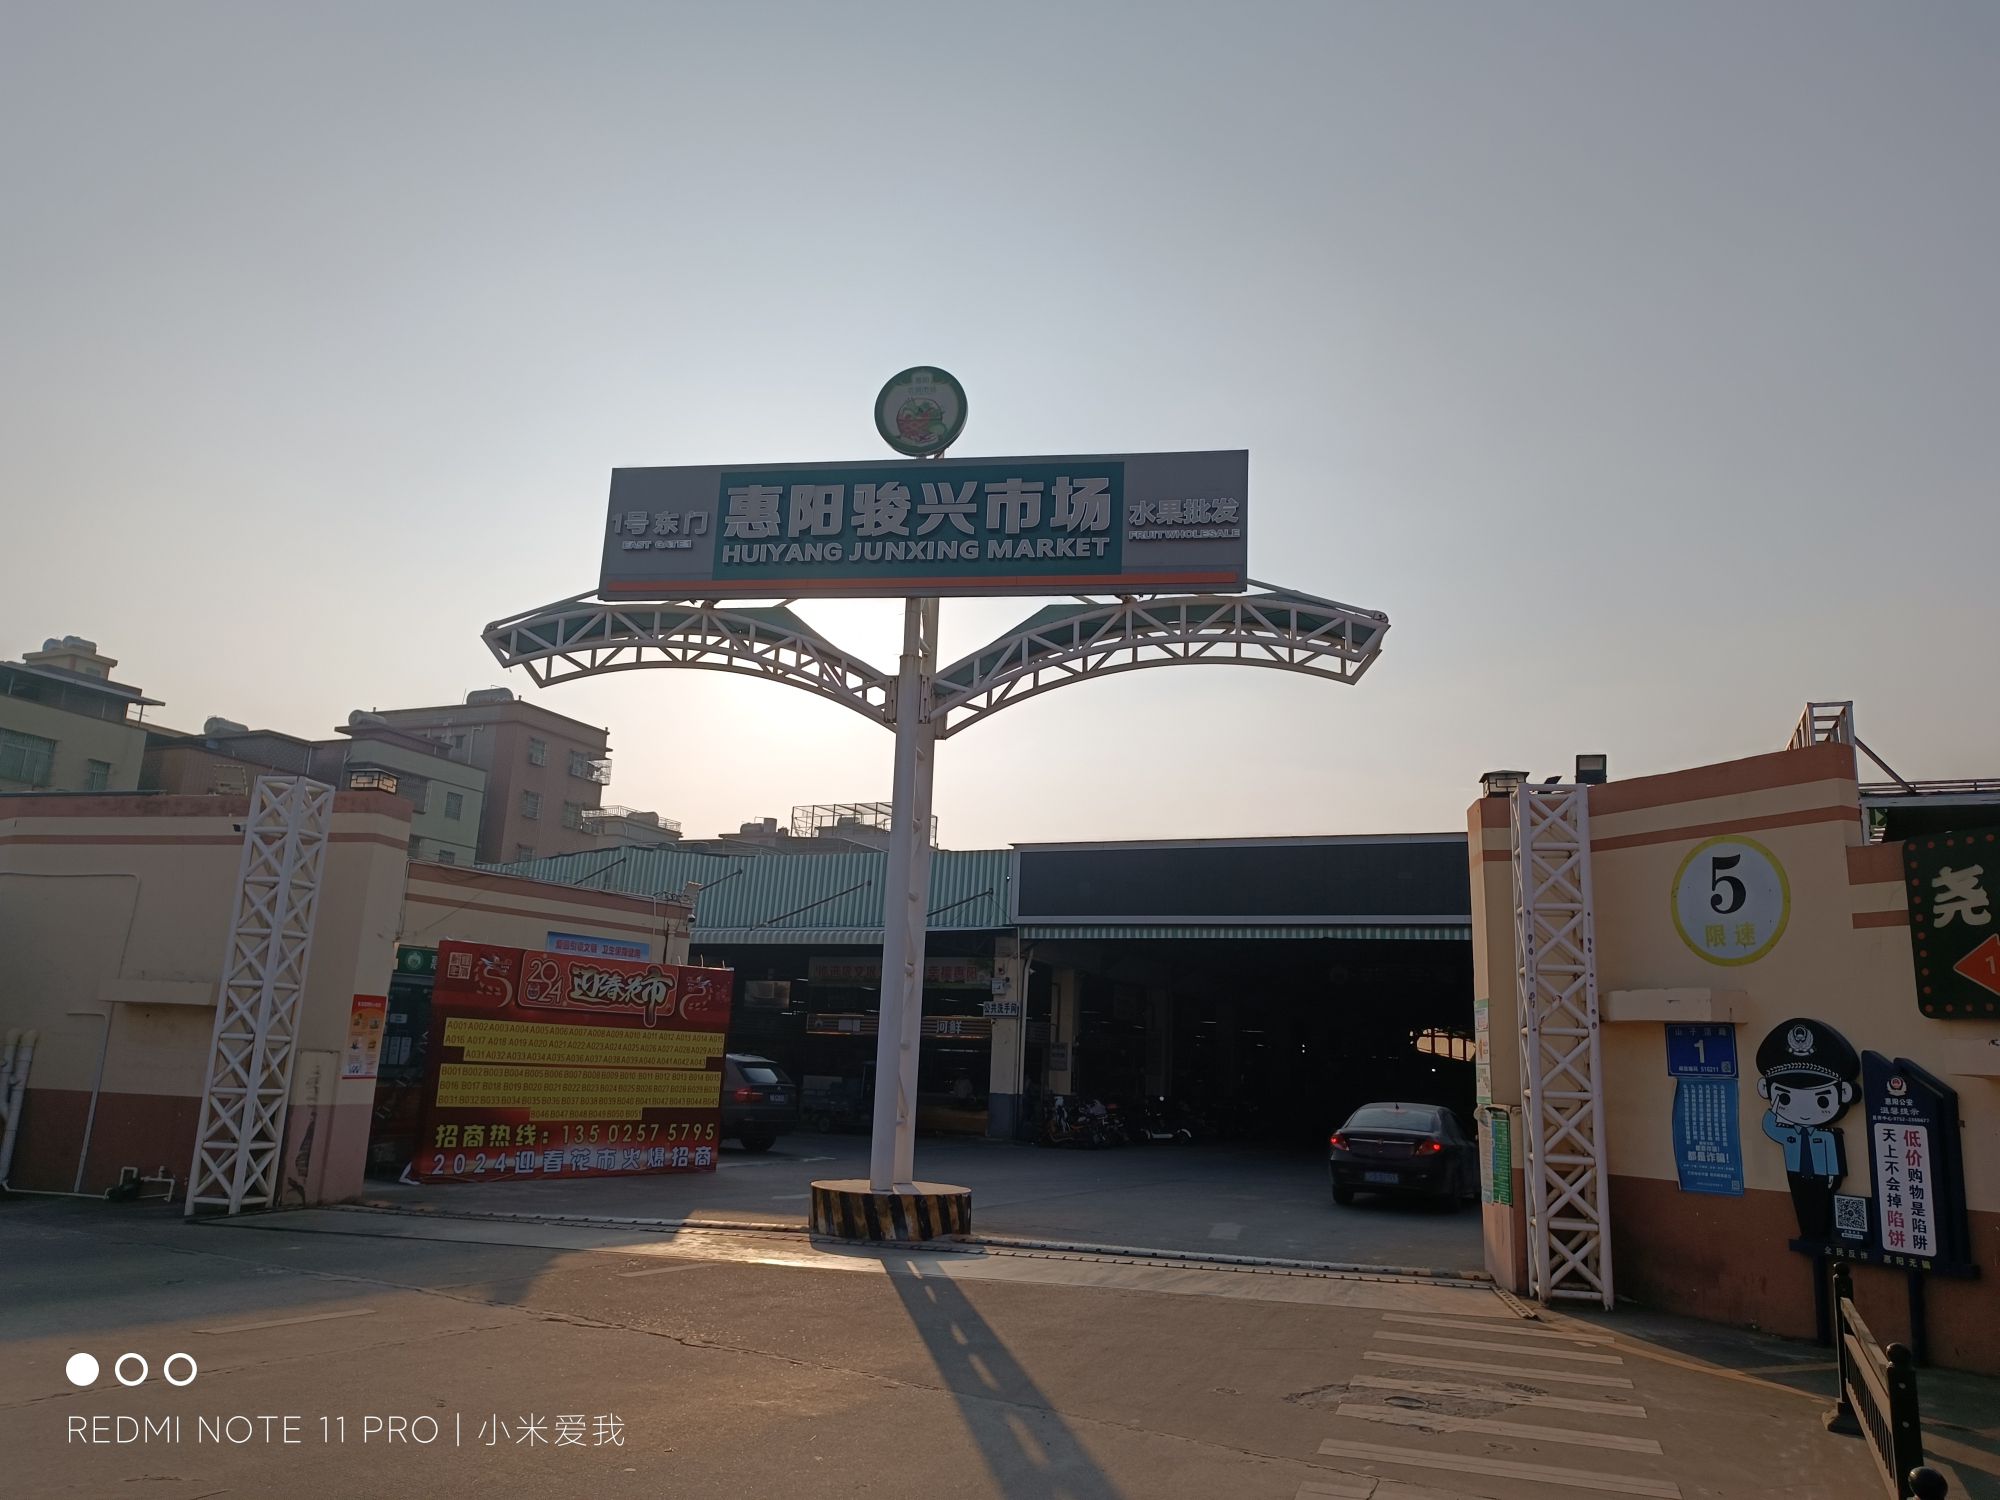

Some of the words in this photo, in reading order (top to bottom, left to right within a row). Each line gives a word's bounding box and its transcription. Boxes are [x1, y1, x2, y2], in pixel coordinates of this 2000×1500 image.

[722, 476, 1111, 539] 惠阳骏兴市场
[1128, 498, 1240, 525] 水果批发
[612, 510, 709, 535] 1号东门
[623, 540, 652, 550] EAST
[722, 542, 843, 563] HUIYANG
[848, 540, 979, 562] JUNXING
[987, 537, 1111, 560] MARKET
[1710, 854, 1747, 914] 5
[1931, 863, 1992, 929] 尧
[1704, 923, 1756, 948] 限速
[1985, 955, 1997, 975] 1
[447, 1021, 466, 1031] A001
[467, 1022, 488, 1033] A002
[489, 1023, 508, 1033] A003
[509, 1024, 528, 1034] A004
[529, 1025, 548, 1035] A005
[550, 1026, 568, 1036] A006
[570, 1028, 586, 1037] A007
[588, 1029, 606, 1038] A008
[606, 1030, 624, 1039] A009
[624, 1031, 641, 1040] A010
[642, 1032, 658, 1041] A011
[659, 1033, 674, 1042] A012
[676, 1034, 690, 1042] A013
[692, 1035, 707, 1043] A014
[446, 1035, 464, 1045] A016
[468, 1036, 486, 1045] A017
[488, 1037, 506, 1046] A018
[510, 1038, 528, 1047] A019
[530, 1039, 547, 1048] A020
[548, 1040, 566, 1049] A021
[567, 1041, 586, 1049] A022
[587, 1042, 605, 1050] A023
[606, 1043, 622, 1051] A024
[622, 1044, 640, 1052] A025
[640, 1044, 657, 1052] A026
[658, 1045, 674, 1053] A027
[674, 1046, 690, 1054] A028
[1694, 1039, 1705, 1064] 1
[466, 1050, 484, 1059] A031
[486, 1051, 506, 1060] A032
[507, 1051, 526, 1061] A033
[527, 1052, 546, 1061] A034
[546, 1053, 565, 1062] A035
[566, 1054, 584, 1063] A036
[585, 1055, 602, 1063] A037
[604, 1056, 621, 1064] A038
[622, 1056, 639, 1064] A039
[639, 1057, 656, 1065] A040
[656, 1058, 673, 1066] A041
[442, 1066, 461, 1076] B001
[462, 1067, 484, 1077] B002
[484, 1068, 504, 1077] B003
[504, 1068, 524, 1078] B004
[524, 1069, 544, 1078] B005
[544, 1070, 563, 1079] B006
[564, 1070, 582, 1079] B007
[583, 1071, 601, 1080] B008
[602, 1071, 619, 1080] B009
[620, 1072, 636, 1080] B010
[638, 1072, 654, 1081] B011
[655, 1073, 670, 1081] B012
[672, 1073, 687, 1082] B013
[688, 1074, 704, 1082] B014
[440, 1081, 459, 1090] B016
[462, 1081, 481, 1091] B017
[483, 1082, 502, 1091] B018
[504, 1082, 522, 1091] B019
[523, 1083, 542, 1092] B020
[544, 1083, 561, 1092] B021
[562, 1084, 581, 1092] B022
[582, 1084, 600, 1092] B023
[600, 1085, 618, 1093] B024
[618, 1085, 636, 1093] B025
[636, 1085, 653, 1093] B026
[671, 1086, 687, 1094] B028
[438, 1096, 458, 1105] B031
[460, 1096, 480, 1105] B032
[480, 1096, 500, 1105] B033
[502, 1096, 521, 1105] B034
[522, 1097, 541, 1105] B035
[542, 1097, 560, 1105] B036
[562, 1097, 579, 1105] B037
[580, 1097, 598, 1105] B038
[599, 1097, 616, 1106] B039
[616, 1098, 635, 1106] B040
[636, 1098, 653, 1106] B041
[653, 1098, 670, 1106] B042
[670, 1098, 686, 1106] B043
[686, 1098, 702, 1106] B044
[1880, 1106, 1920, 1116] 温馨提示
[1884, 1097, 1913, 1106] 惠阳公安
[530, 1110, 548, 1119] B046
[550, 1110, 568, 1119] B047
[570, 1110, 588, 1119] B048
[588, 1110, 606, 1119] B049
[606, 1110, 624, 1119] B050
[626, 1110, 641, 1119] B051
[562, 1124, 599, 1144] 135
[607, 1123, 658, 1143] 0257
[667, 1123, 715, 1142] 5795
[1882, 1128, 1906, 1248] 天上不会掉陷饼
[1904, 1129, 1928, 1250] 低价购物是陷阱
